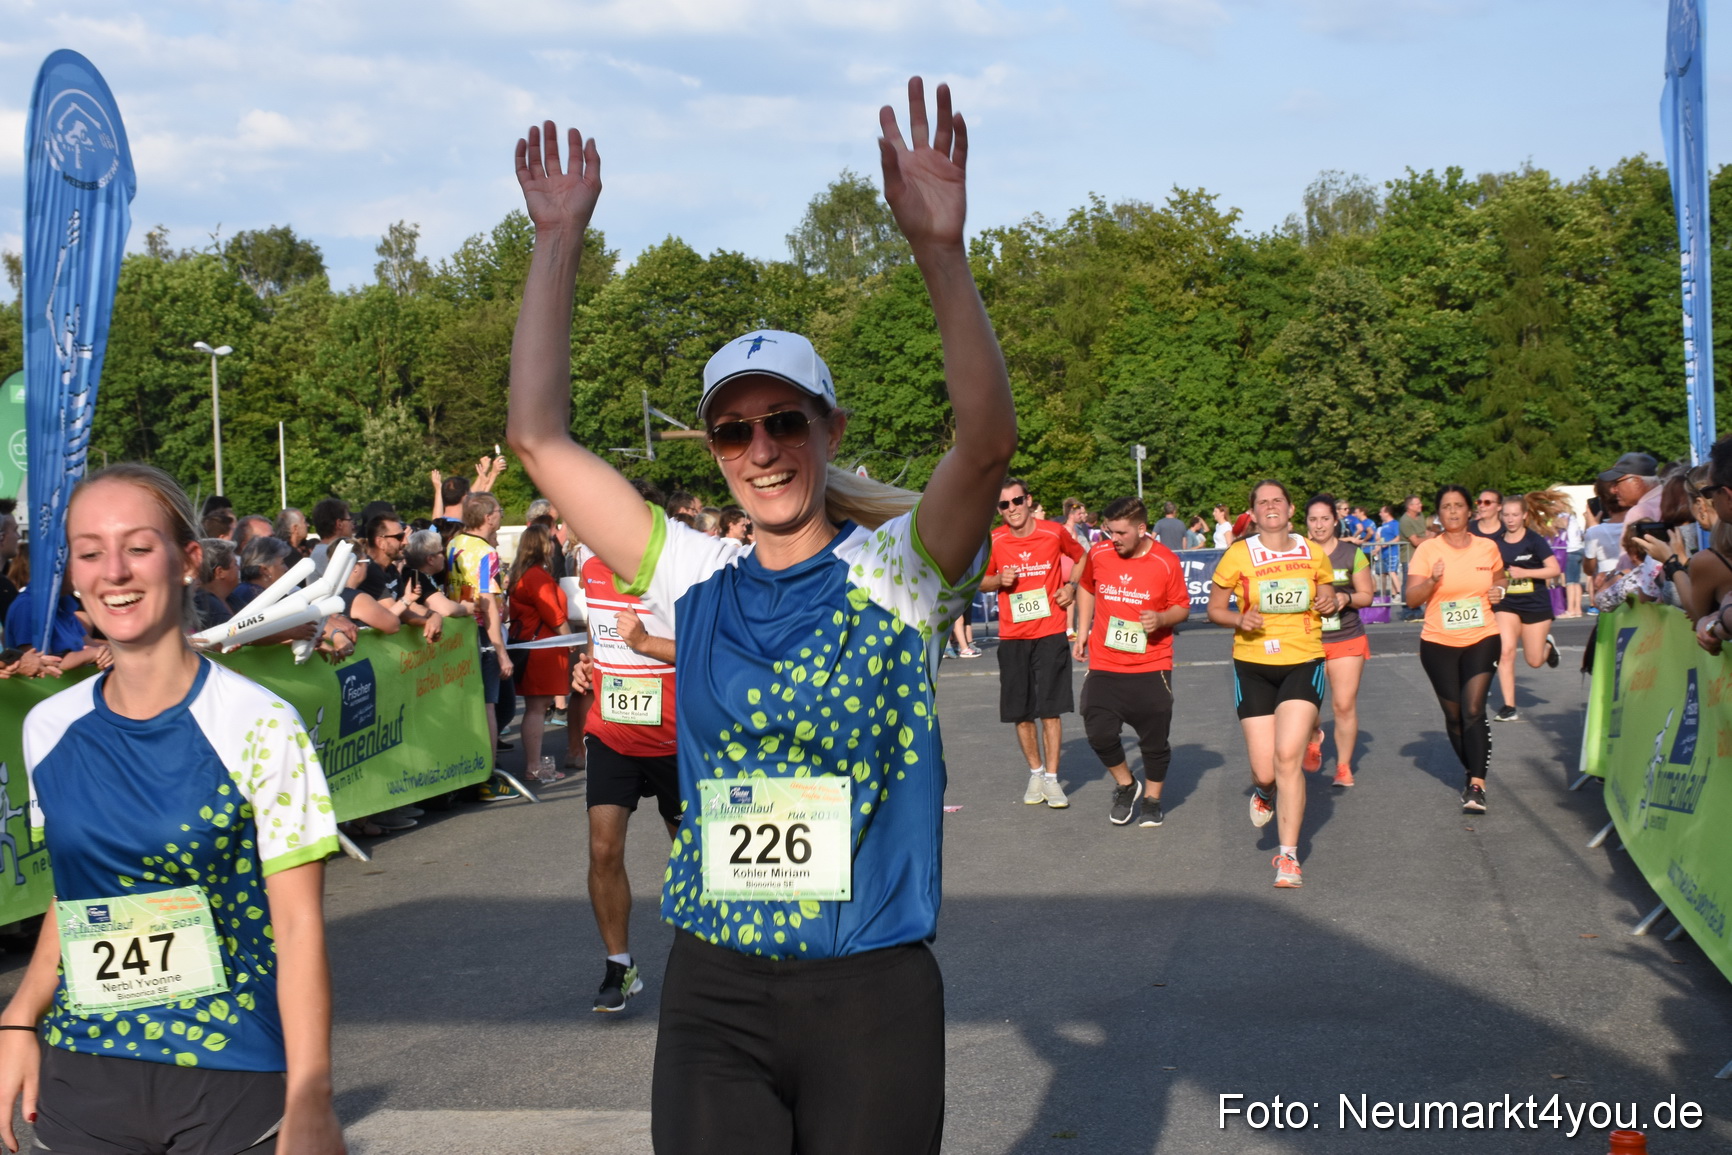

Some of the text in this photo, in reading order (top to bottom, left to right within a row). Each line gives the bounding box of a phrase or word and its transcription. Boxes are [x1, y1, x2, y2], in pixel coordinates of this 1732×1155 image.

[1255, 566, 1282, 577] MAX
[1266, 591, 1303, 605] 1627
[1018, 600, 1040, 614] 608
[1446, 608, 1479, 622] 2302
[1115, 630, 1138, 644] 616
[347, 682, 372, 700] Fischer
[608, 692, 653, 711] 1817
[322, 703, 405, 776] firmenlauf
[330, 766, 364, 794] eumarkt
[729, 823, 812, 865] 226
[733, 868, 810, 878] Kohler Miriam
[92, 932, 175, 981] 247
[102, 974, 182, 993] Nerbl Yvonne
[117, 985, 169, 1000] Bionorica SE
